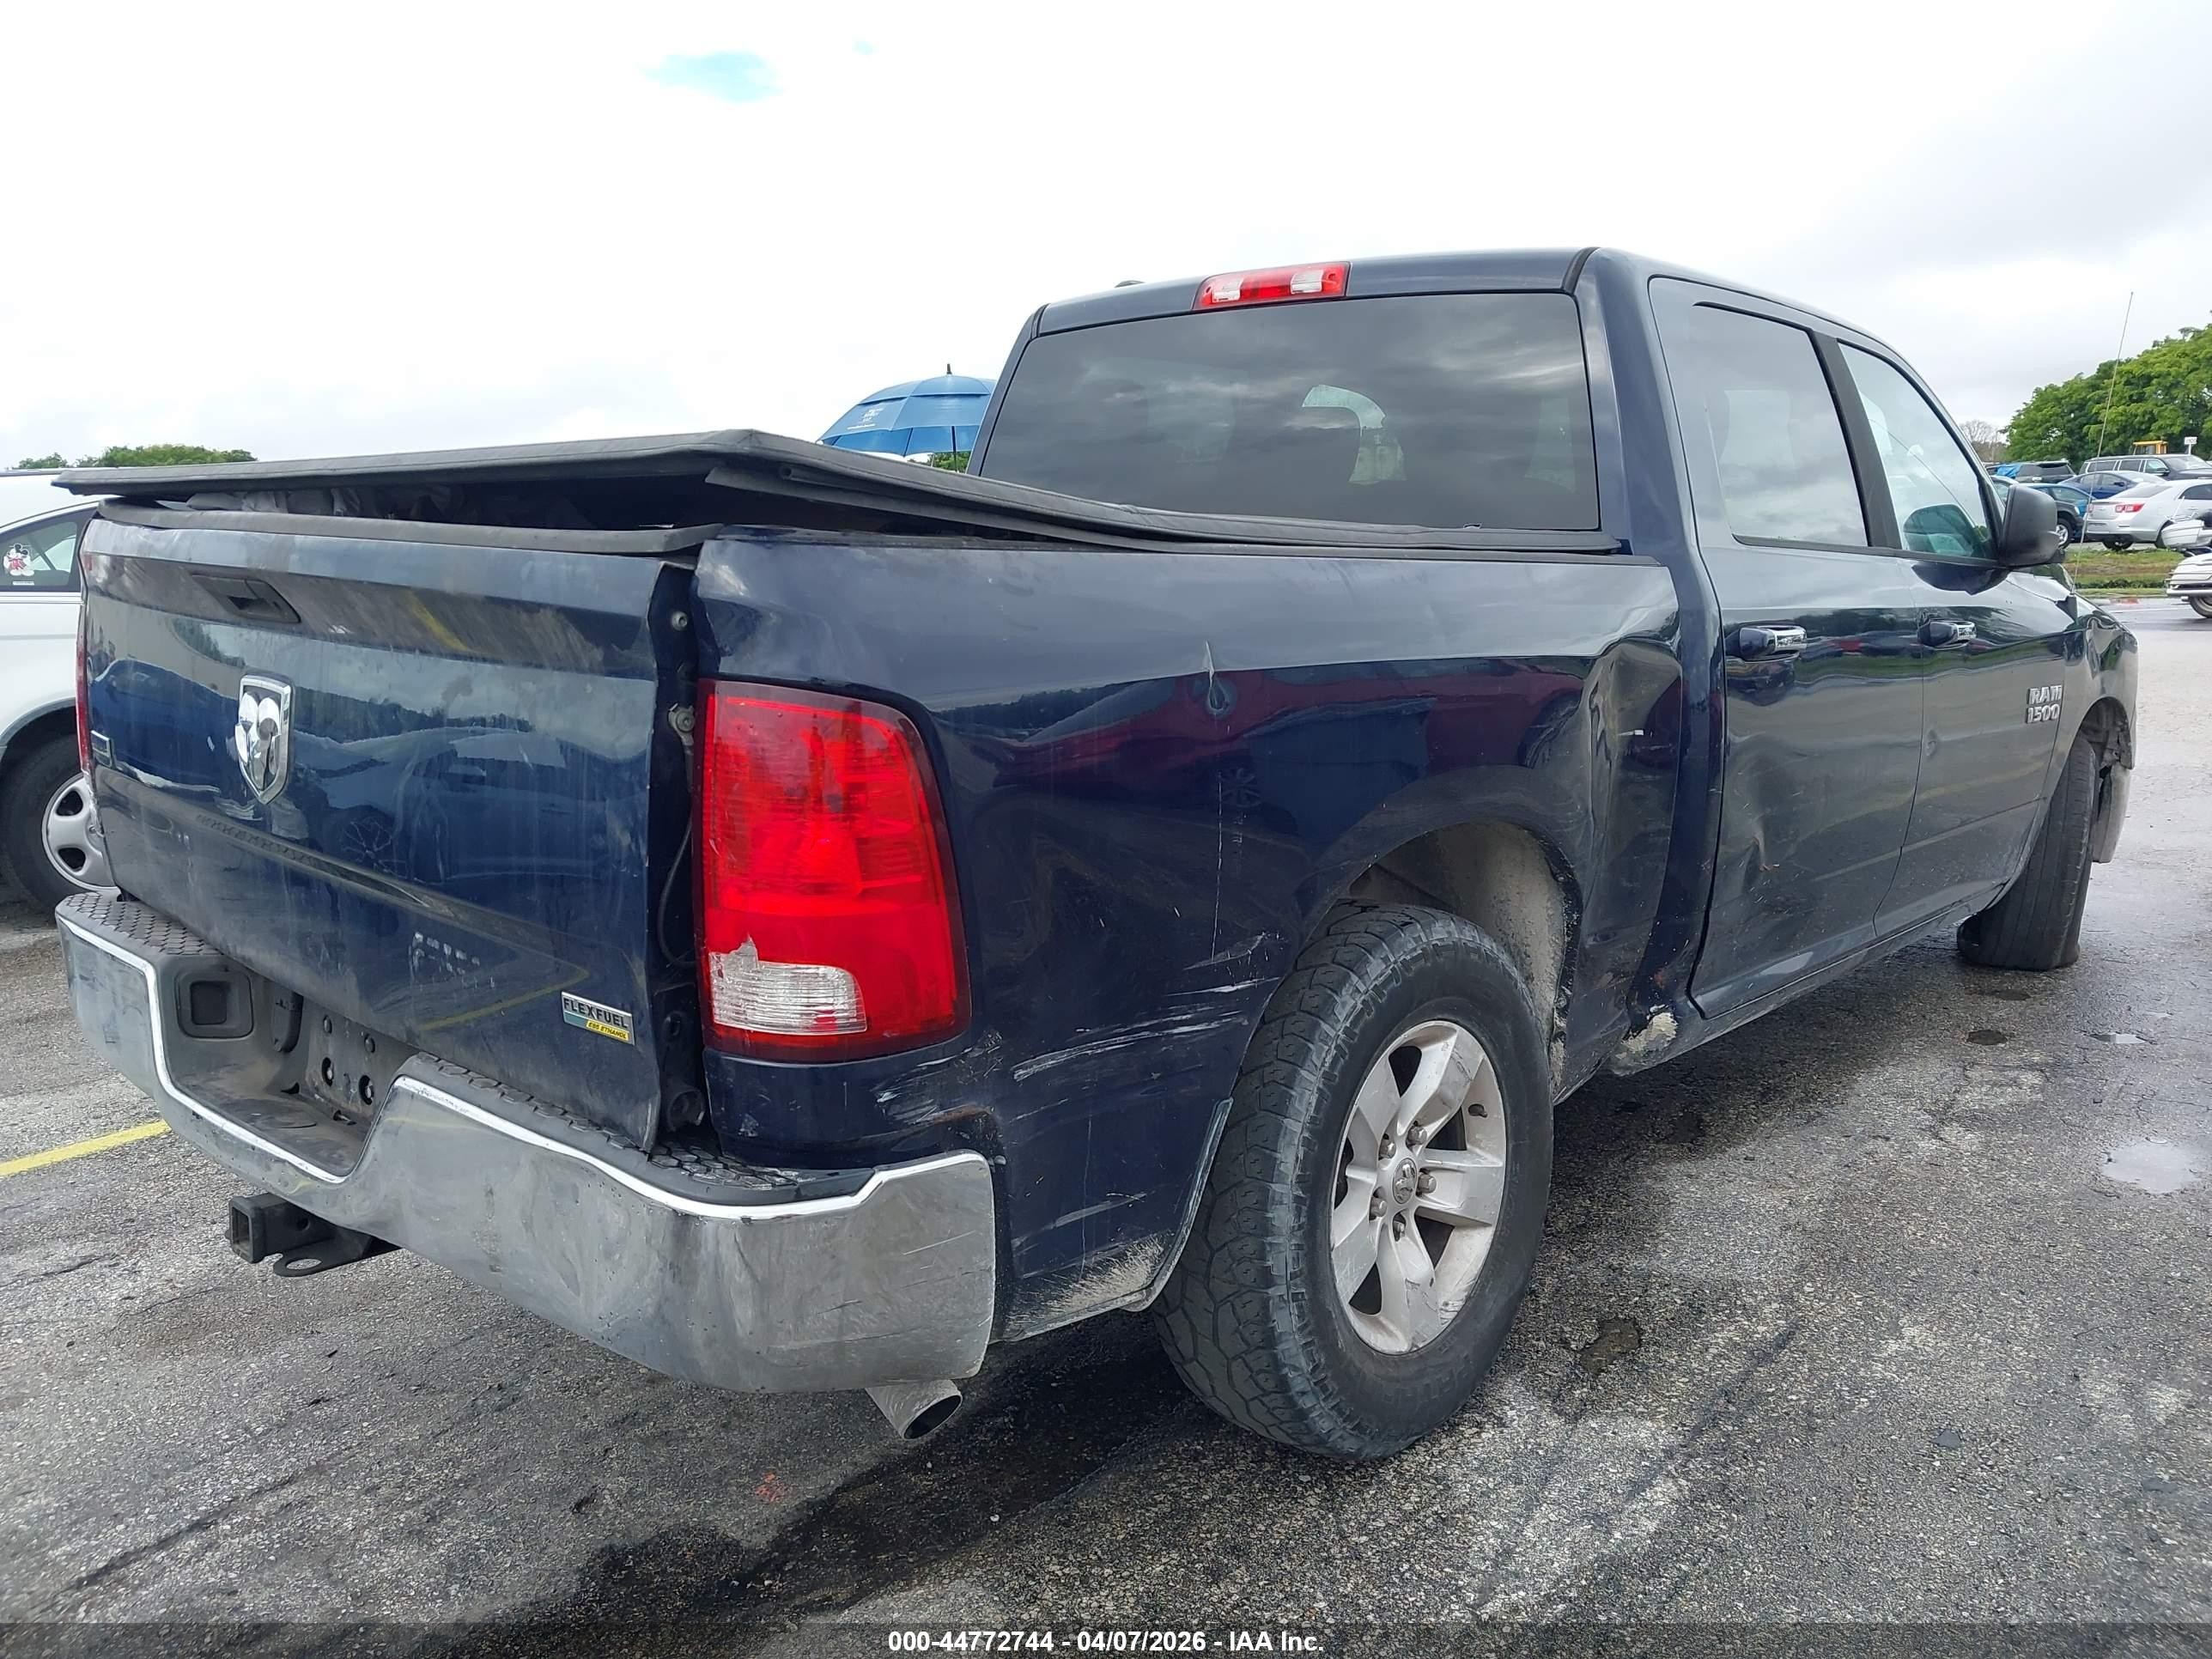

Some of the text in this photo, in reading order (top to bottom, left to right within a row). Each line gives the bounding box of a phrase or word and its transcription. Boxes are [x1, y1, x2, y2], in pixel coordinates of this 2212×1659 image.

[2027, 685, 2063, 704] RAM
[2026, 703, 2060, 723] 1500
[562, 997, 629, 1029] FLEXFUEL
[601, 1025, 627, 1039] ETHANOL
